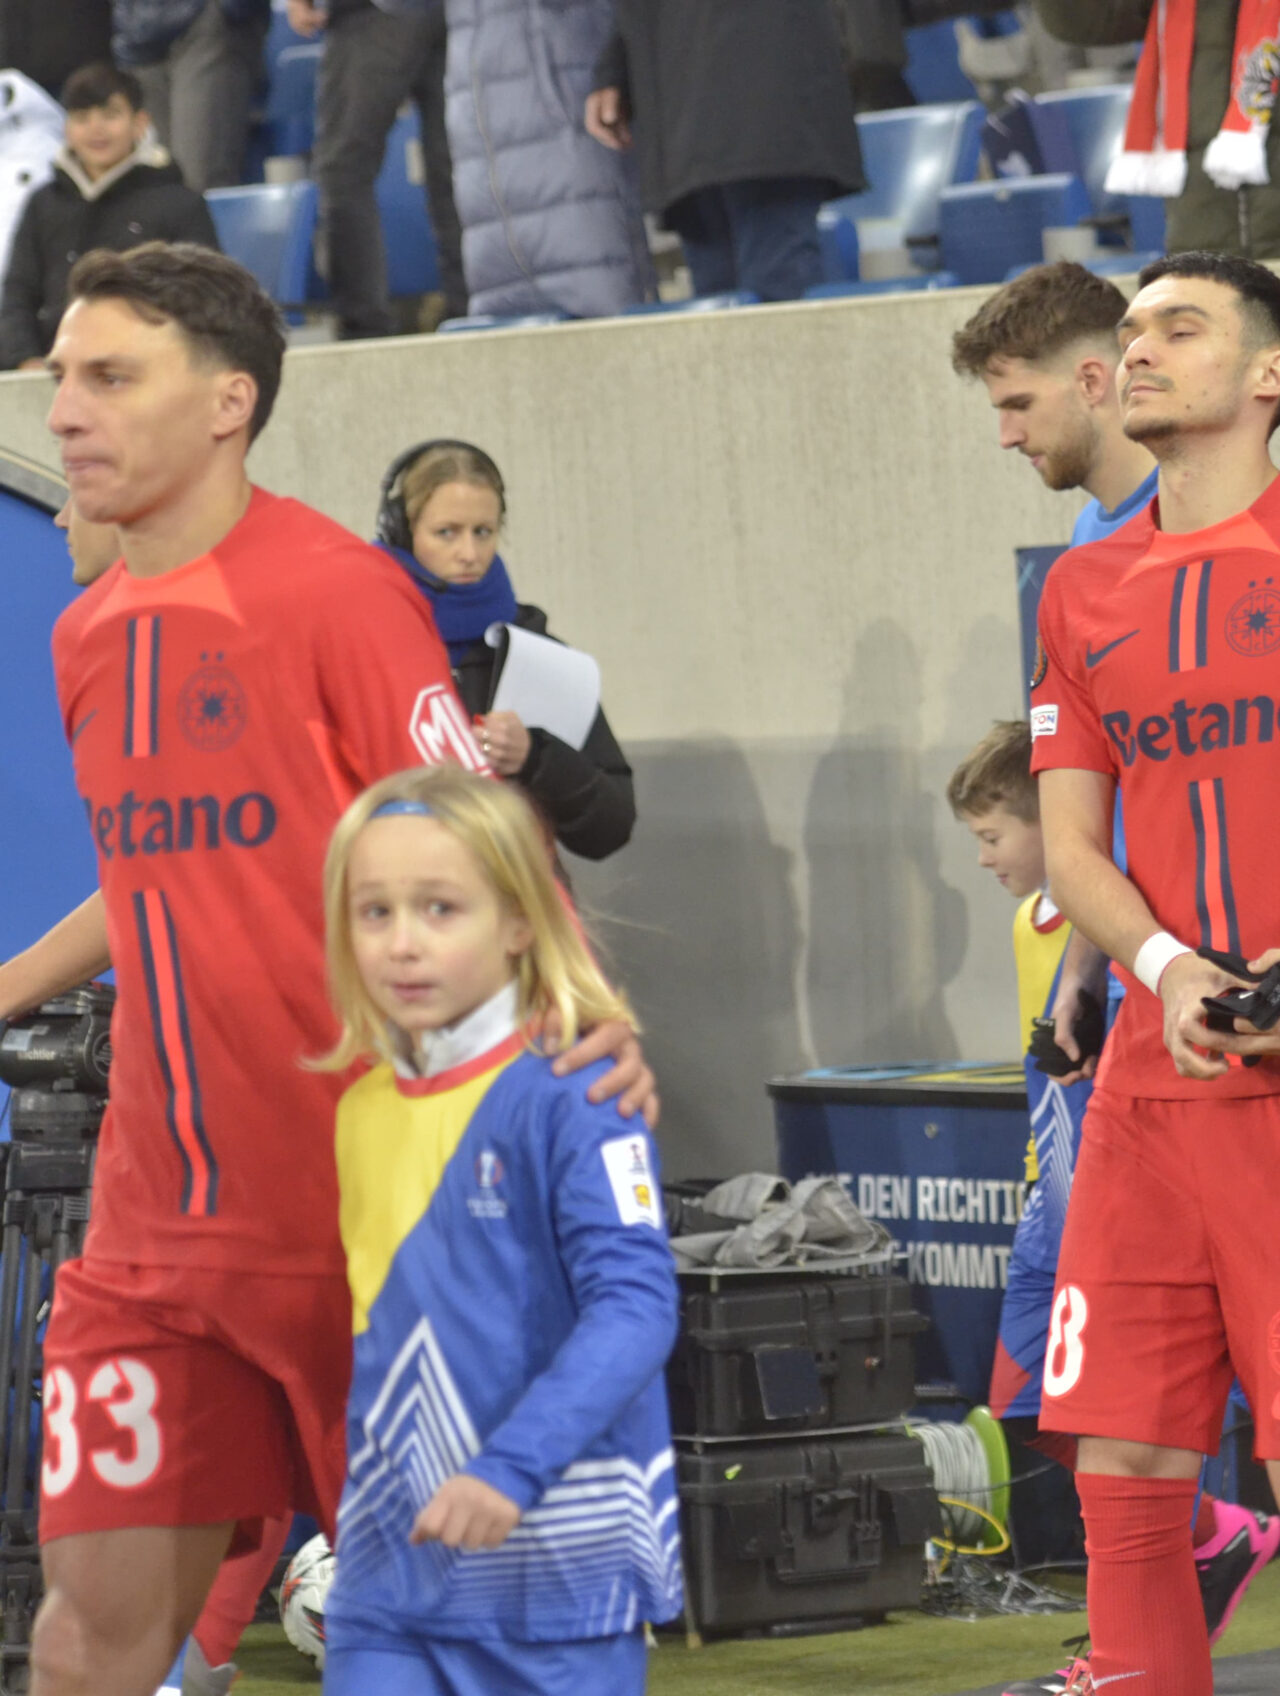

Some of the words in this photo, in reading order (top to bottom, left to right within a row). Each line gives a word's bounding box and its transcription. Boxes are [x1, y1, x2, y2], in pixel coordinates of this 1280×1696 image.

[82, 790, 277, 860] etano
[858, 1173, 911, 1220] DEN
[1042, 1284, 1089, 1397] 8
[43, 1357, 163, 1496] 33
